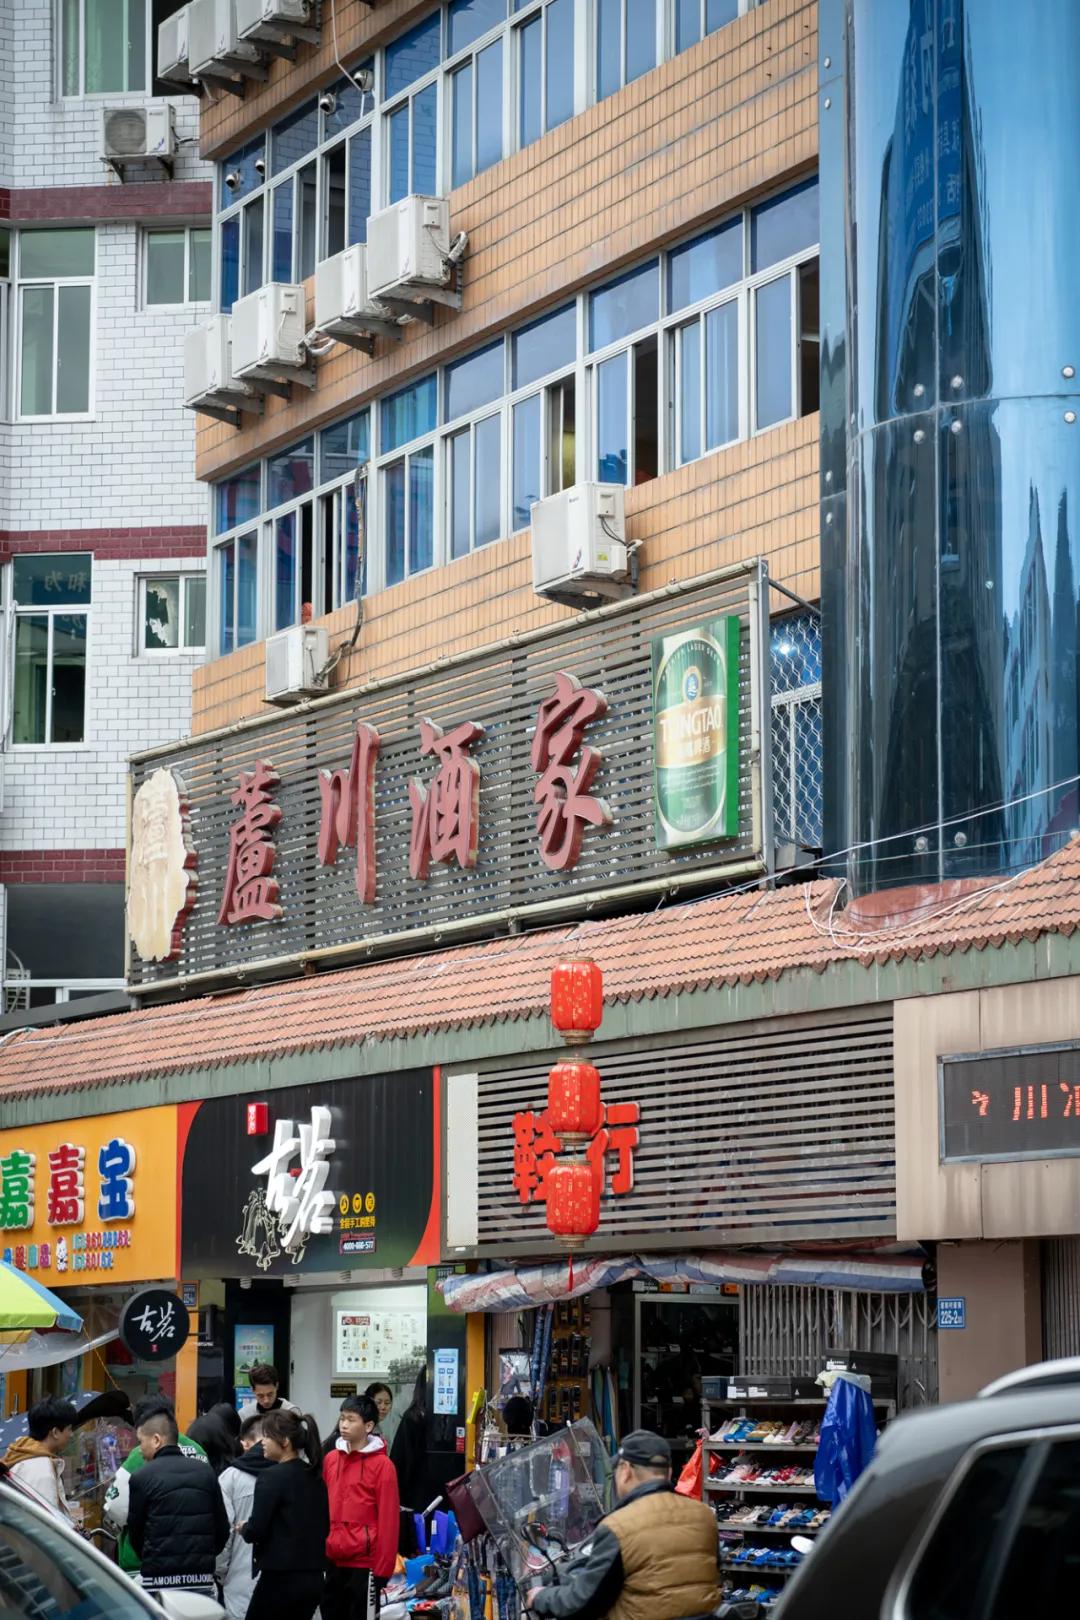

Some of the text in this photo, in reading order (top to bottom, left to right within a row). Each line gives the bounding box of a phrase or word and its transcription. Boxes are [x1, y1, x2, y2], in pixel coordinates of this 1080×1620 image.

[659, 704, 722, 744] TNGTAO
[0, 1137, 136, 1230] 嘉嘉宝
[130, 1301, 176, 1342] 古茗
